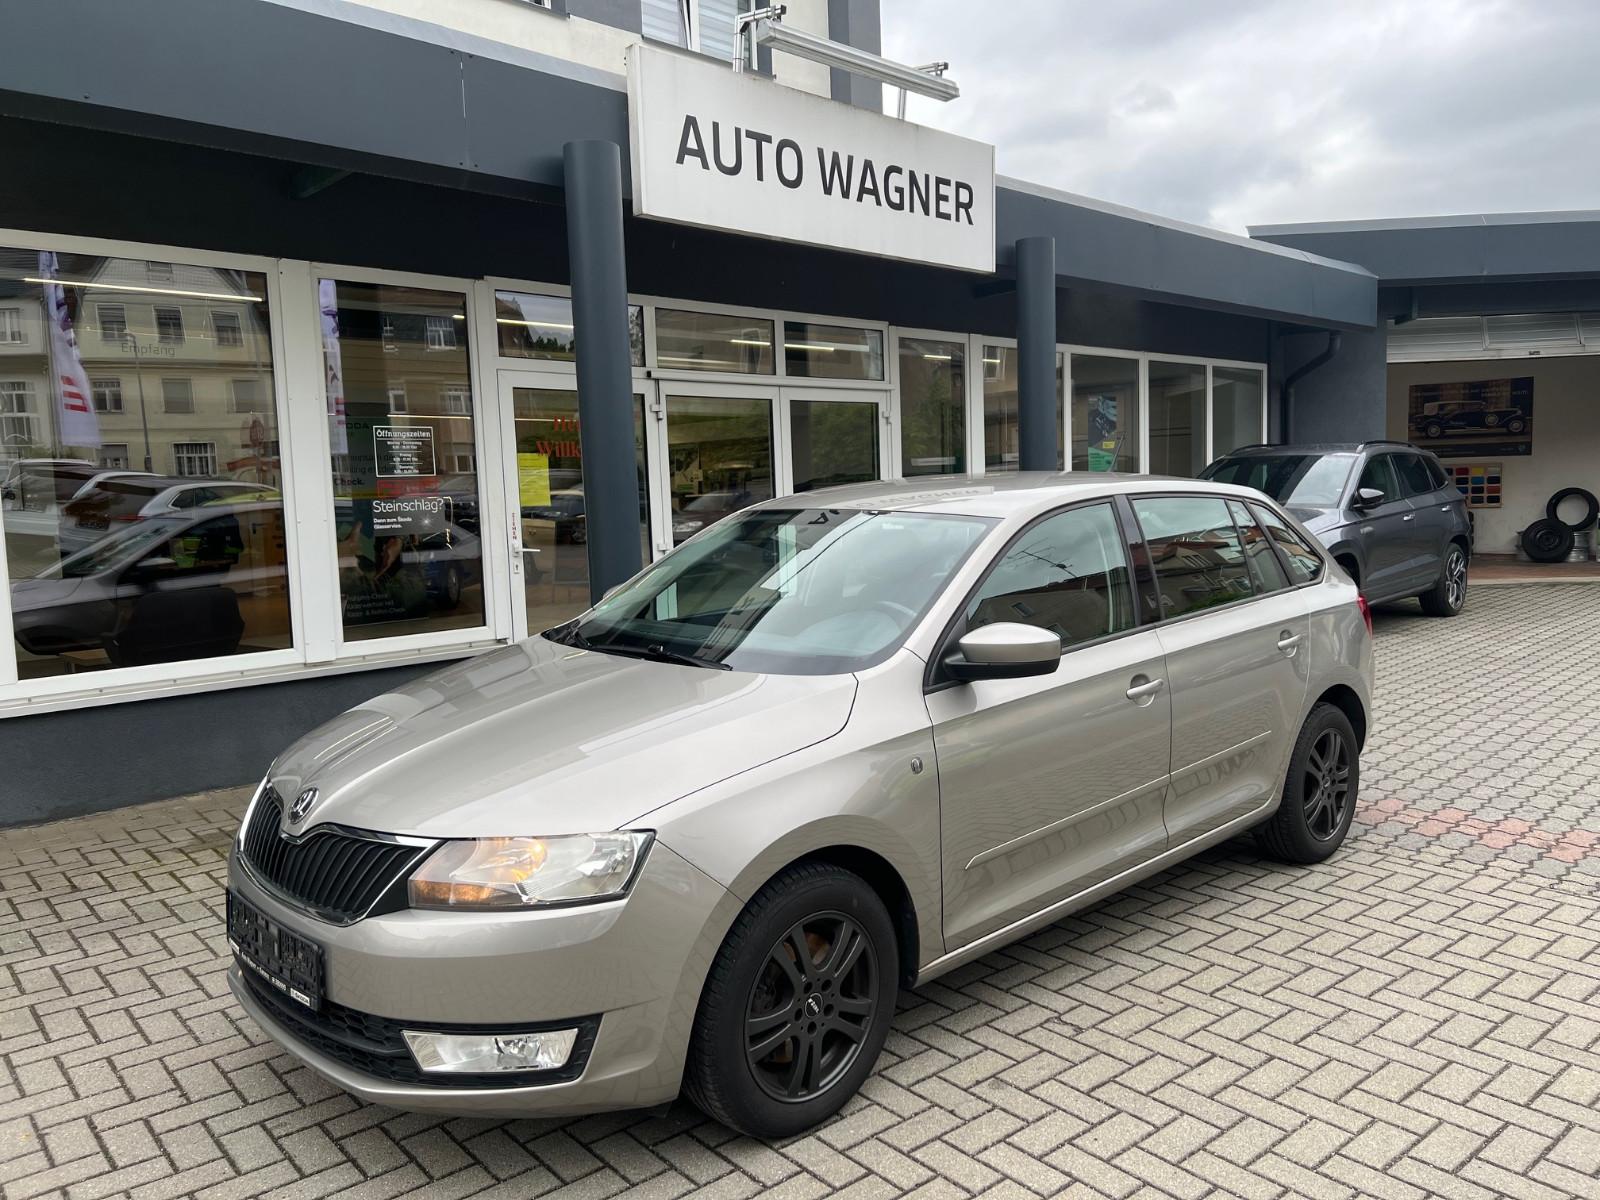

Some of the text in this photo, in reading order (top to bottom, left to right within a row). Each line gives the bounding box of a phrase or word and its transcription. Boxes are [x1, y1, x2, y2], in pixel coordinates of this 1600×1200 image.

[675, 114, 975, 226] AUTO WAGNER
[121, 342, 176, 357] Empfang
[376, 429, 431, 439] Öffnungszeiten
[372, 498, 444, 513] Steinschlag?
